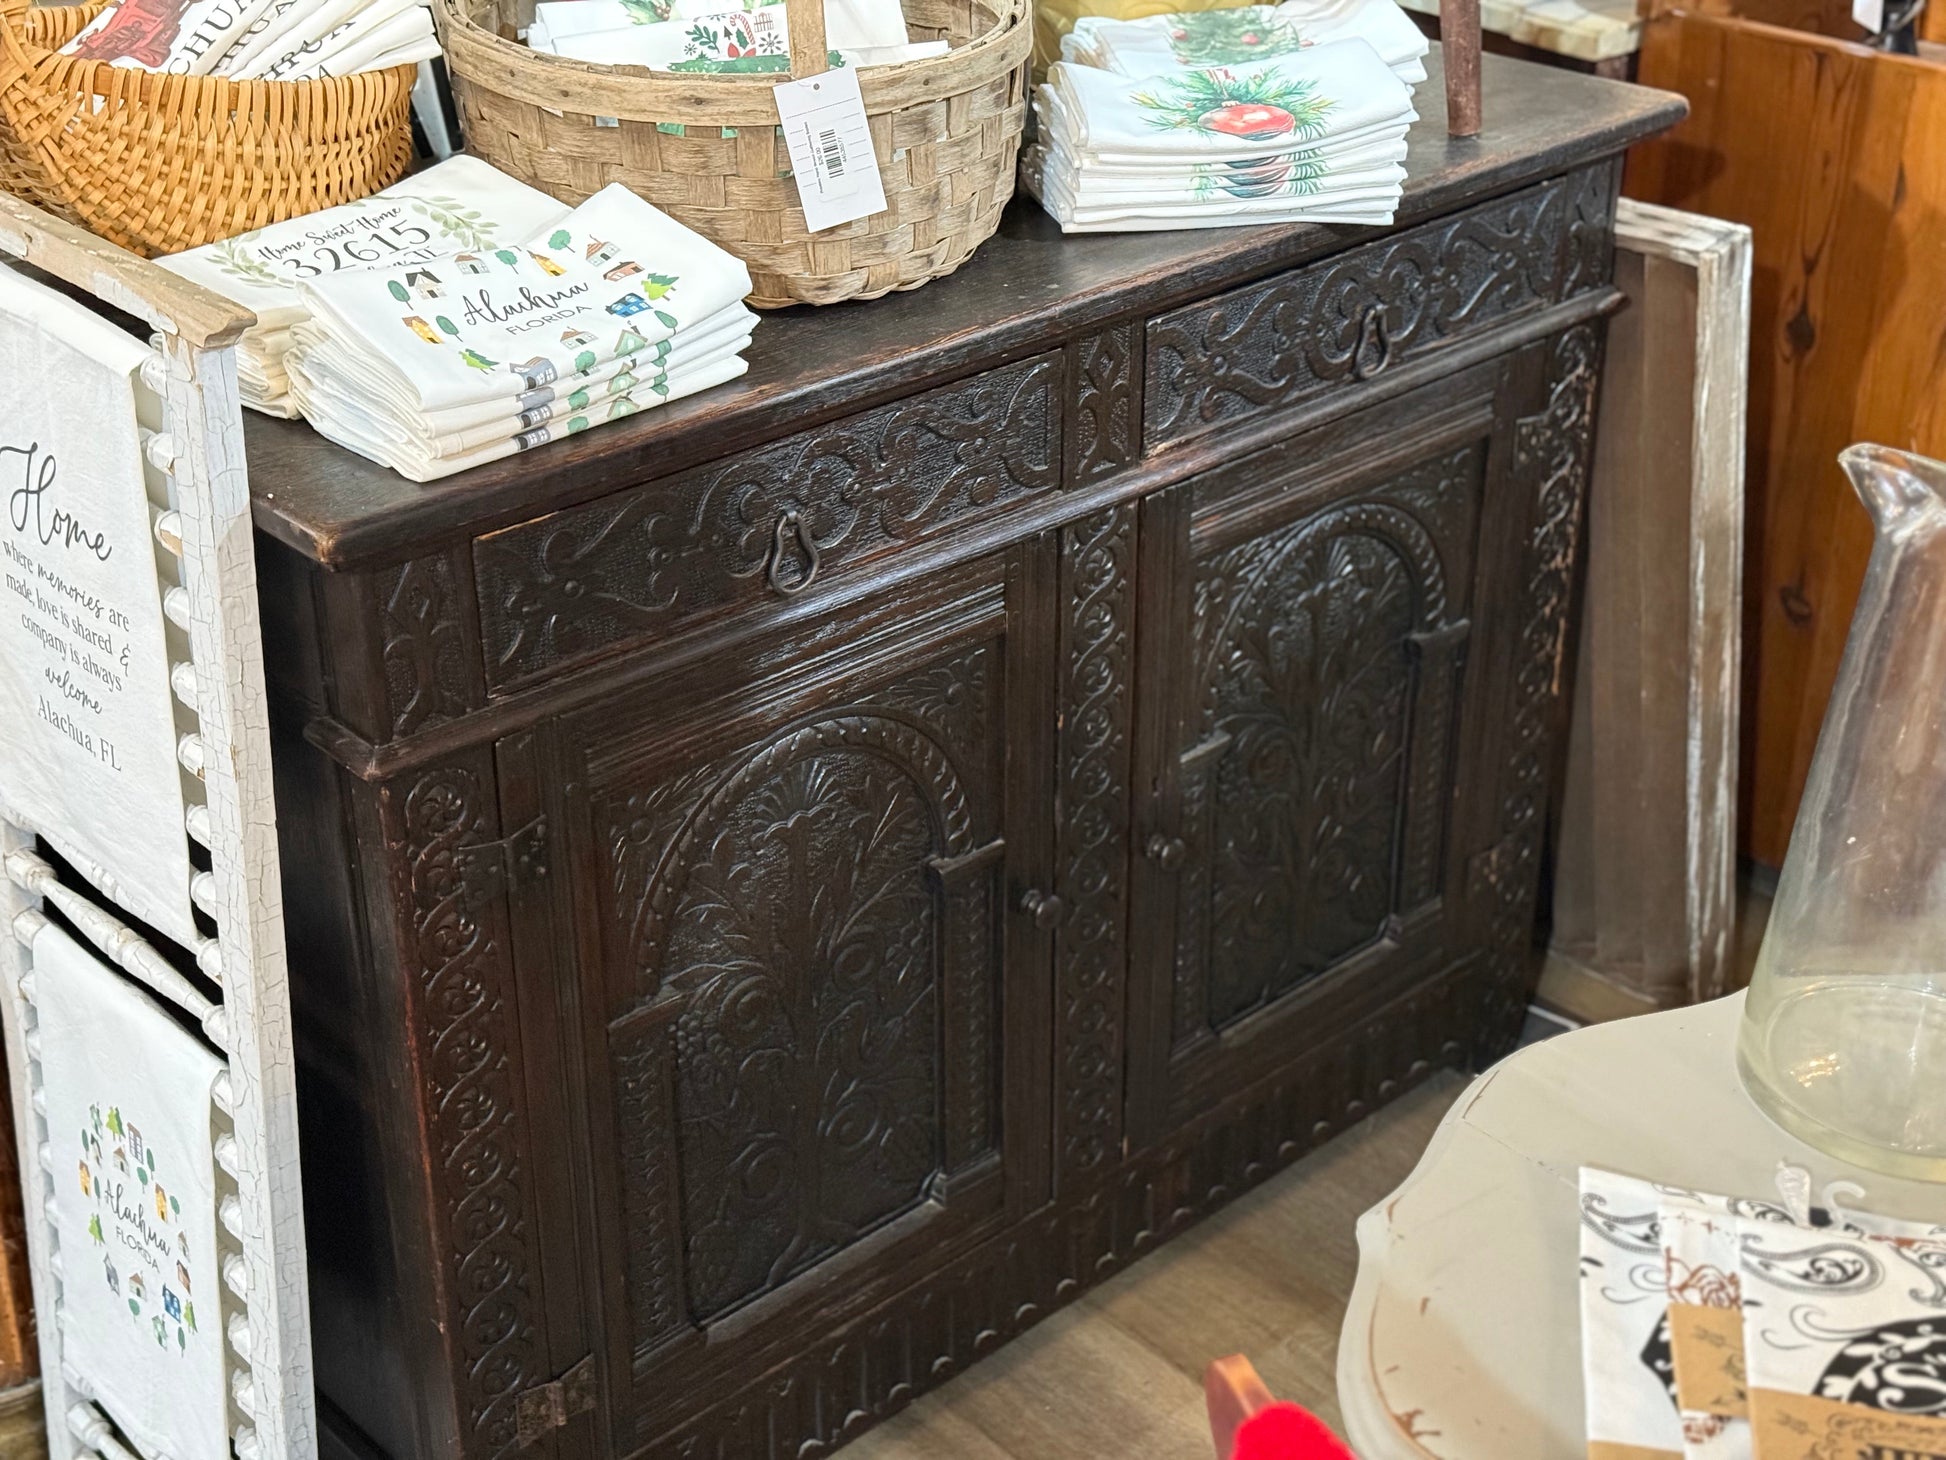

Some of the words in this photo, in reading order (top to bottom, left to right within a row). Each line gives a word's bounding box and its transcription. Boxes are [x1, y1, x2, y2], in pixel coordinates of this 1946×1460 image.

[258, 239, 306, 261] Home
[305, 221, 355, 246] Sweet
[356, 207, 402, 230] Home
[282, 219, 431, 278] 32615
[462, 282, 588, 326] Alachua
[505, 305, 592, 335] FLORIDA
[0, 442, 112, 561] Home
[3, 540, 33, 574] where
[38, 563, 104, 619] memories
[109, 608, 130, 632] are
[22, 613, 67, 661] company
[69, 643, 80, 666] is
[82, 653, 122, 692] always
[36, 588, 58, 620] love
[60, 606, 70, 628] is
[71, 615, 113, 655] shared
[120, 643, 131, 677] &
[45, 667, 102, 714] welcome
[100, 737, 122, 772] FL
[105, 1178, 170, 1256] Alachua
